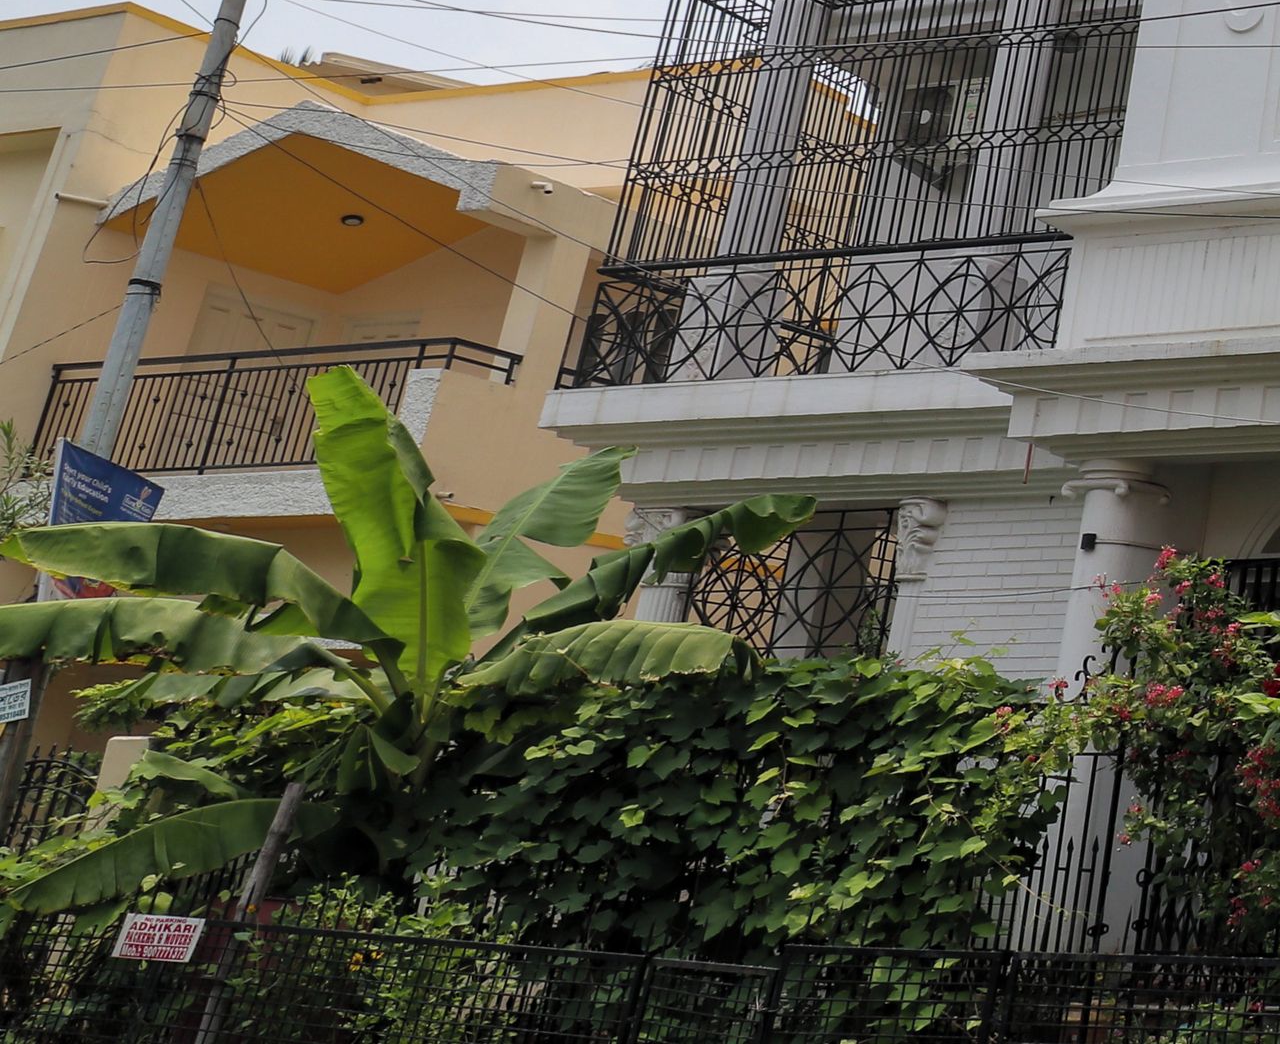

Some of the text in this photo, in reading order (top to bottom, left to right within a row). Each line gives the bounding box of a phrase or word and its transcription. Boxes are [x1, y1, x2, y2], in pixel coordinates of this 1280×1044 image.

[77, 482, 109, 503] Education
[129, 921, 198, 933] ADHIKARI
[124, 931, 157, 944] PACKERS
[164, 934, 193, 946] MOVERS
